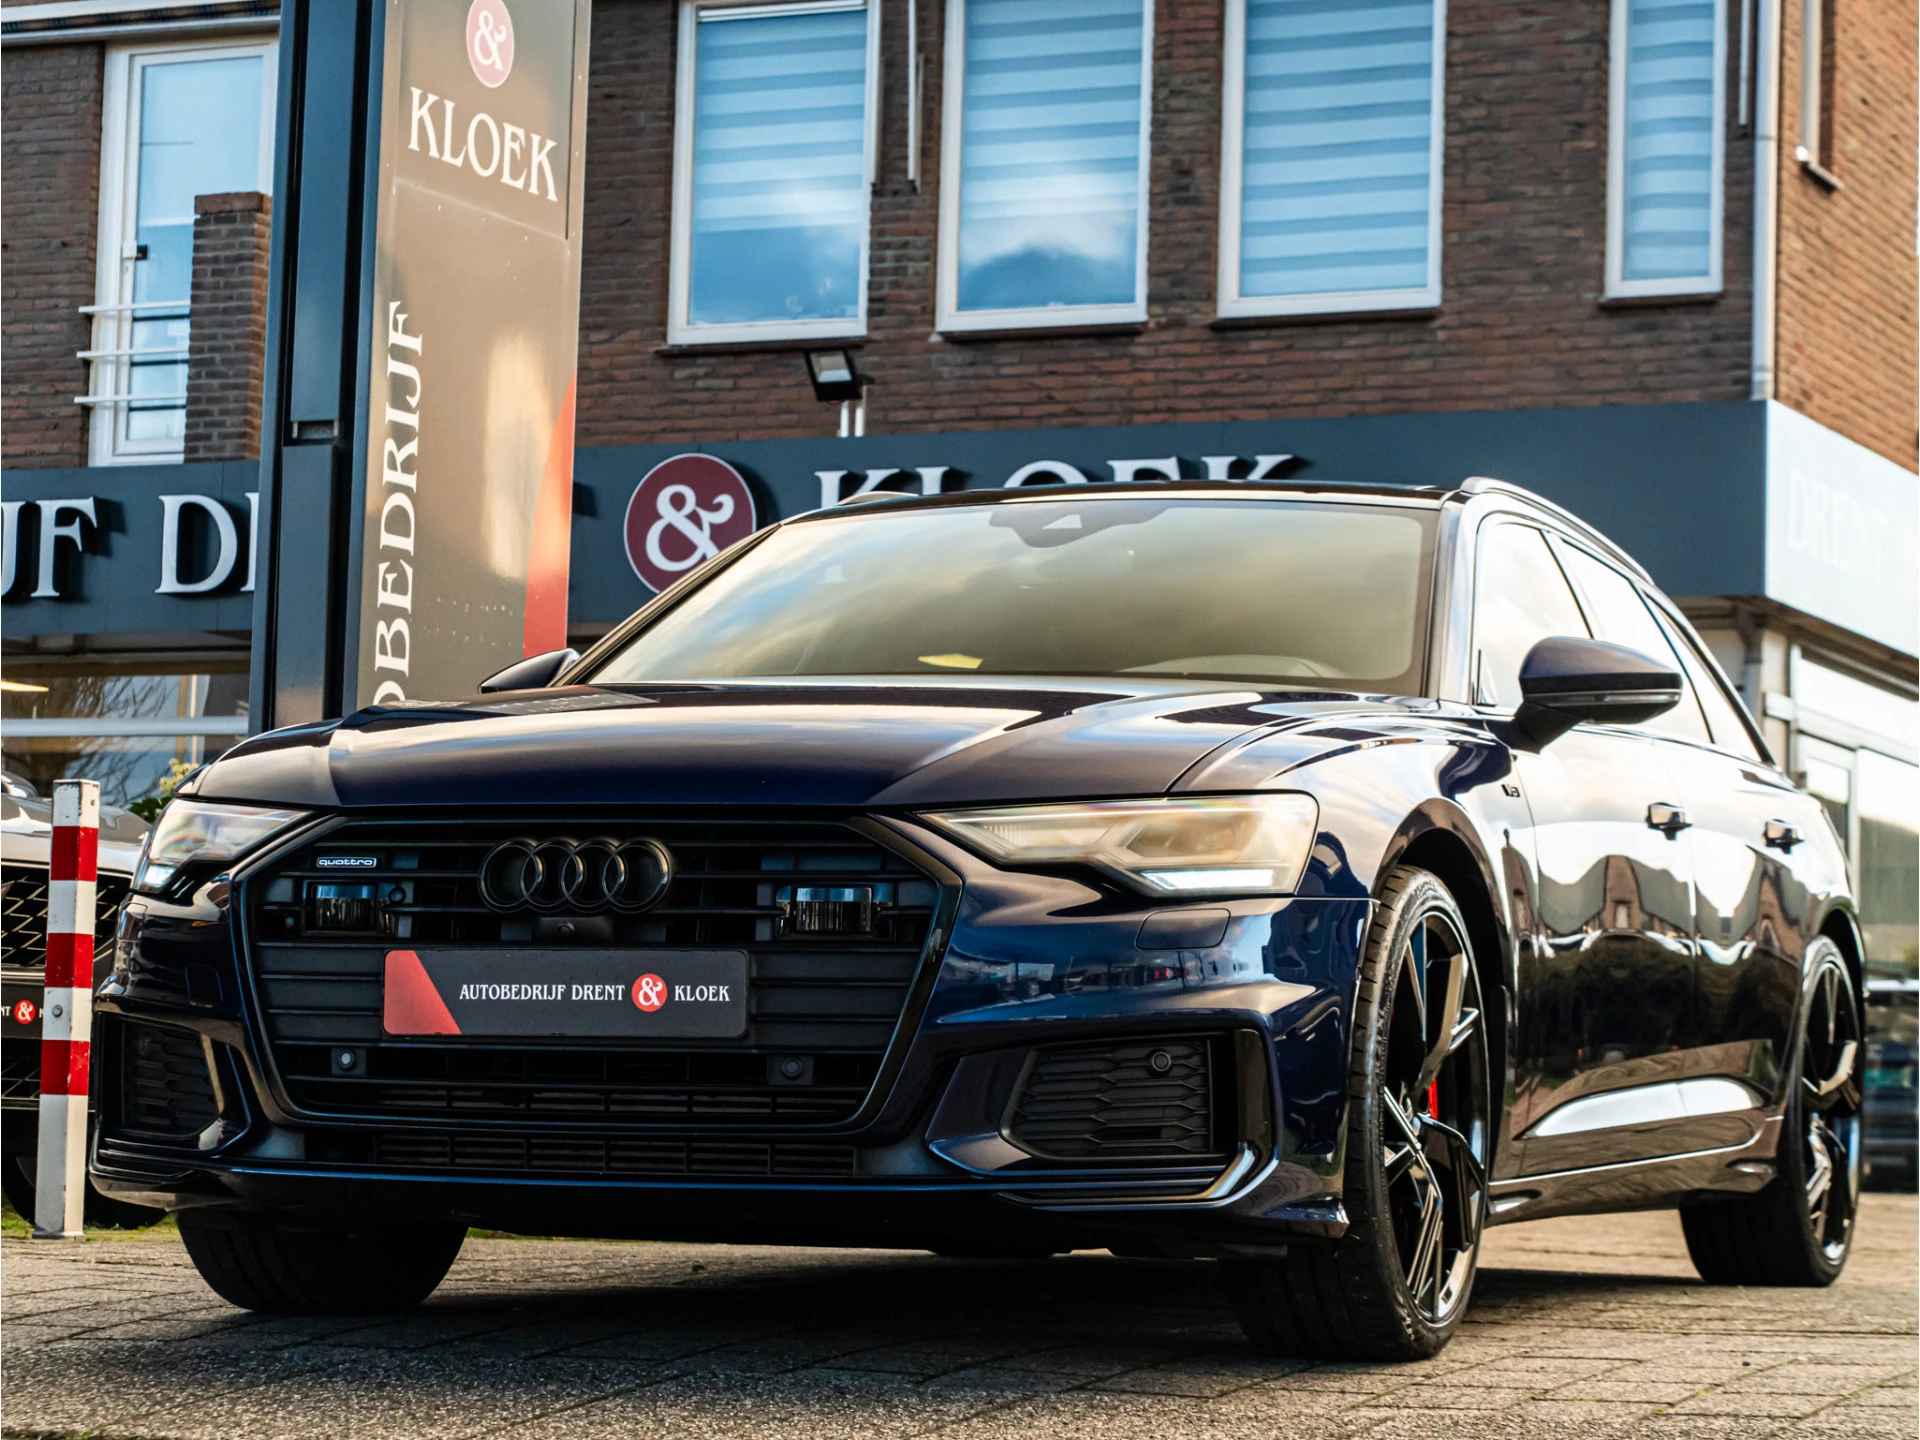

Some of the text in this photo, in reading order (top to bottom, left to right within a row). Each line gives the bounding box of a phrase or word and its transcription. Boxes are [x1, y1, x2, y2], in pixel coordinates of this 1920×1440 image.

[474, 10, 507, 71] &
[408, 86, 558, 202] KLOEK
[646, 484, 734, 571] &
[318, 858, 373, 867] quattro
[18, 1002, 33, 1021] &
[459, 977, 730, 1006] AUTOBEDRIJF DRENT & KLOEK
